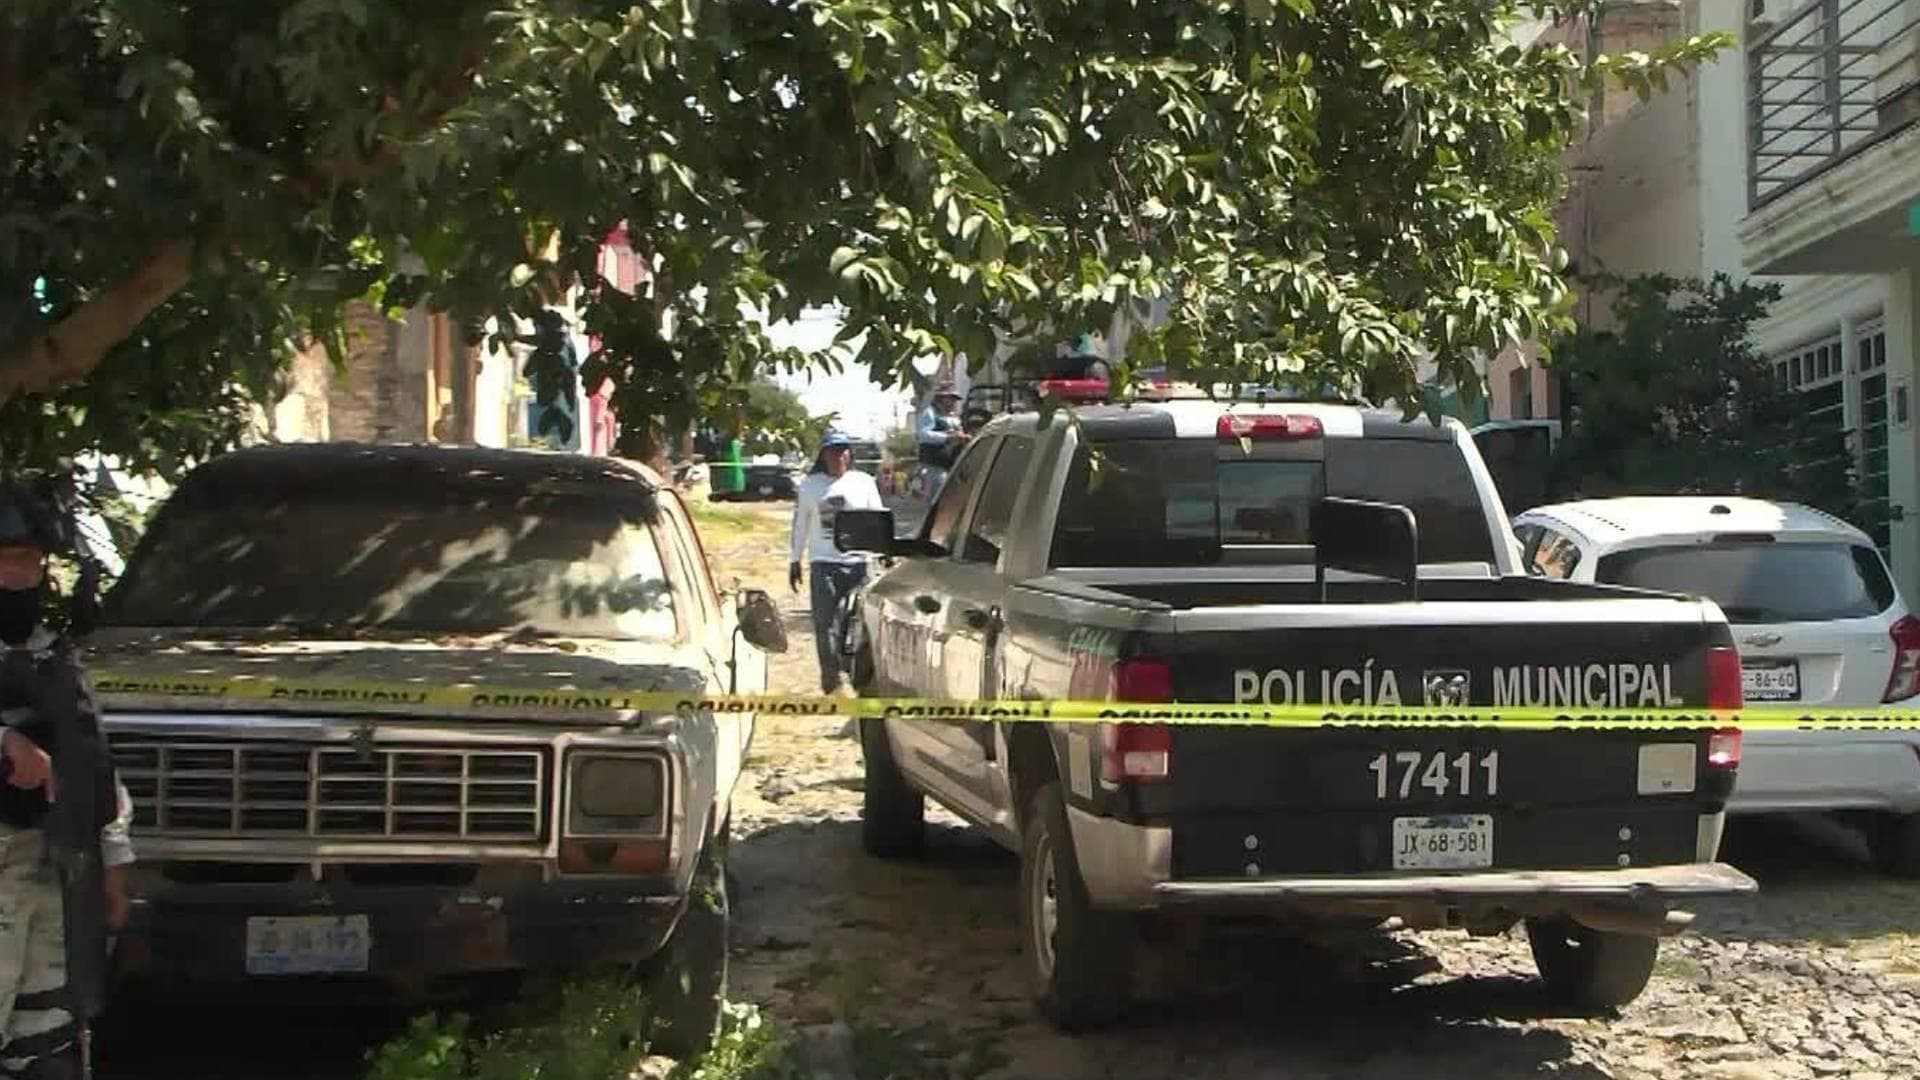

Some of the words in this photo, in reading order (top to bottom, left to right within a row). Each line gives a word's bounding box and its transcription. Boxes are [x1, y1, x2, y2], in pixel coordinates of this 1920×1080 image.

[1233, 658, 1402, 706] POLICÍA
[1492, 663, 1684, 707] MUNICIPAL
[1368, 751, 1499, 799] 17411
[1399, 831, 1487, 855] JX-68-581
